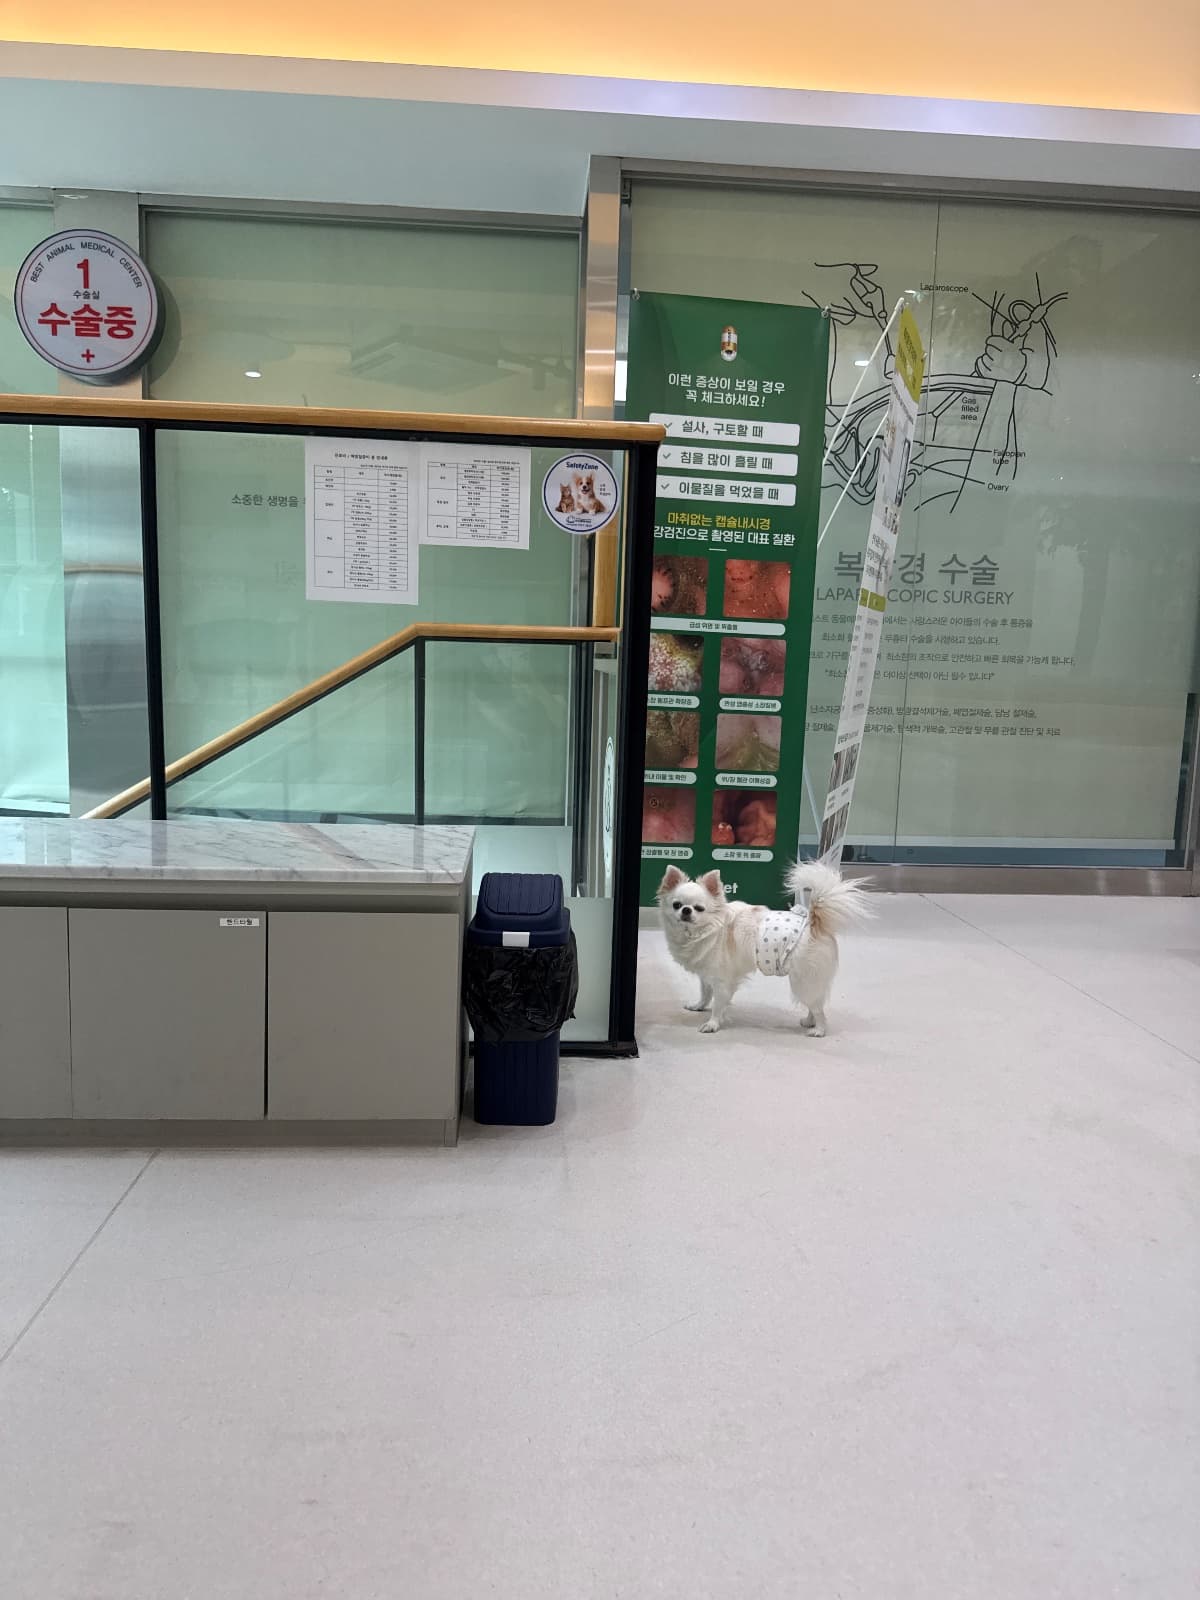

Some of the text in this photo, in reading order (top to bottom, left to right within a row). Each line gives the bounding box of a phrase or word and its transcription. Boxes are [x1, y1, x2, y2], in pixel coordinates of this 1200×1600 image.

[30, 241, 143, 289] BEST ANIMAL MEDICAL CENTER
[77, 258, 90, 289] 1
[73, 290, 100, 300] 수술실
[920, 282, 969, 293] Laparoscope
[38, 302, 137, 340] 수술중
[668, 372, 785, 396] 이런 증상이 보일 경우
[685, 388, 767, 408] 꼭 체크하세요!
[961, 396, 977, 405] Gas
[960, 413, 978, 421] area
[961, 405, 980, 413] filled
[682, 420, 764, 439] 설사, 구토할 때
[565, 460, 599, 471] SafetyZone
[680, 451, 773, 471] 침을 많이 흘릴 때
[679, 481, 780, 501] 이물질을 먹었을 때
[987, 483, 1010, 493] Ovary
[231, 493, 300, 508] 소중한 생명을
[667, 511, 772, 531] 마취없는 캡슐내시경
[711, 529, 745, 544] 촬영된
[747, 531, 771, 545] 대표
[772, 533, 797, 547] 질환
[833, 551, 926, 585] 복경
[938, 553, 1000, 586] 수술
[816, 588, 1014, 605] LAPACOPIC SURGERY
